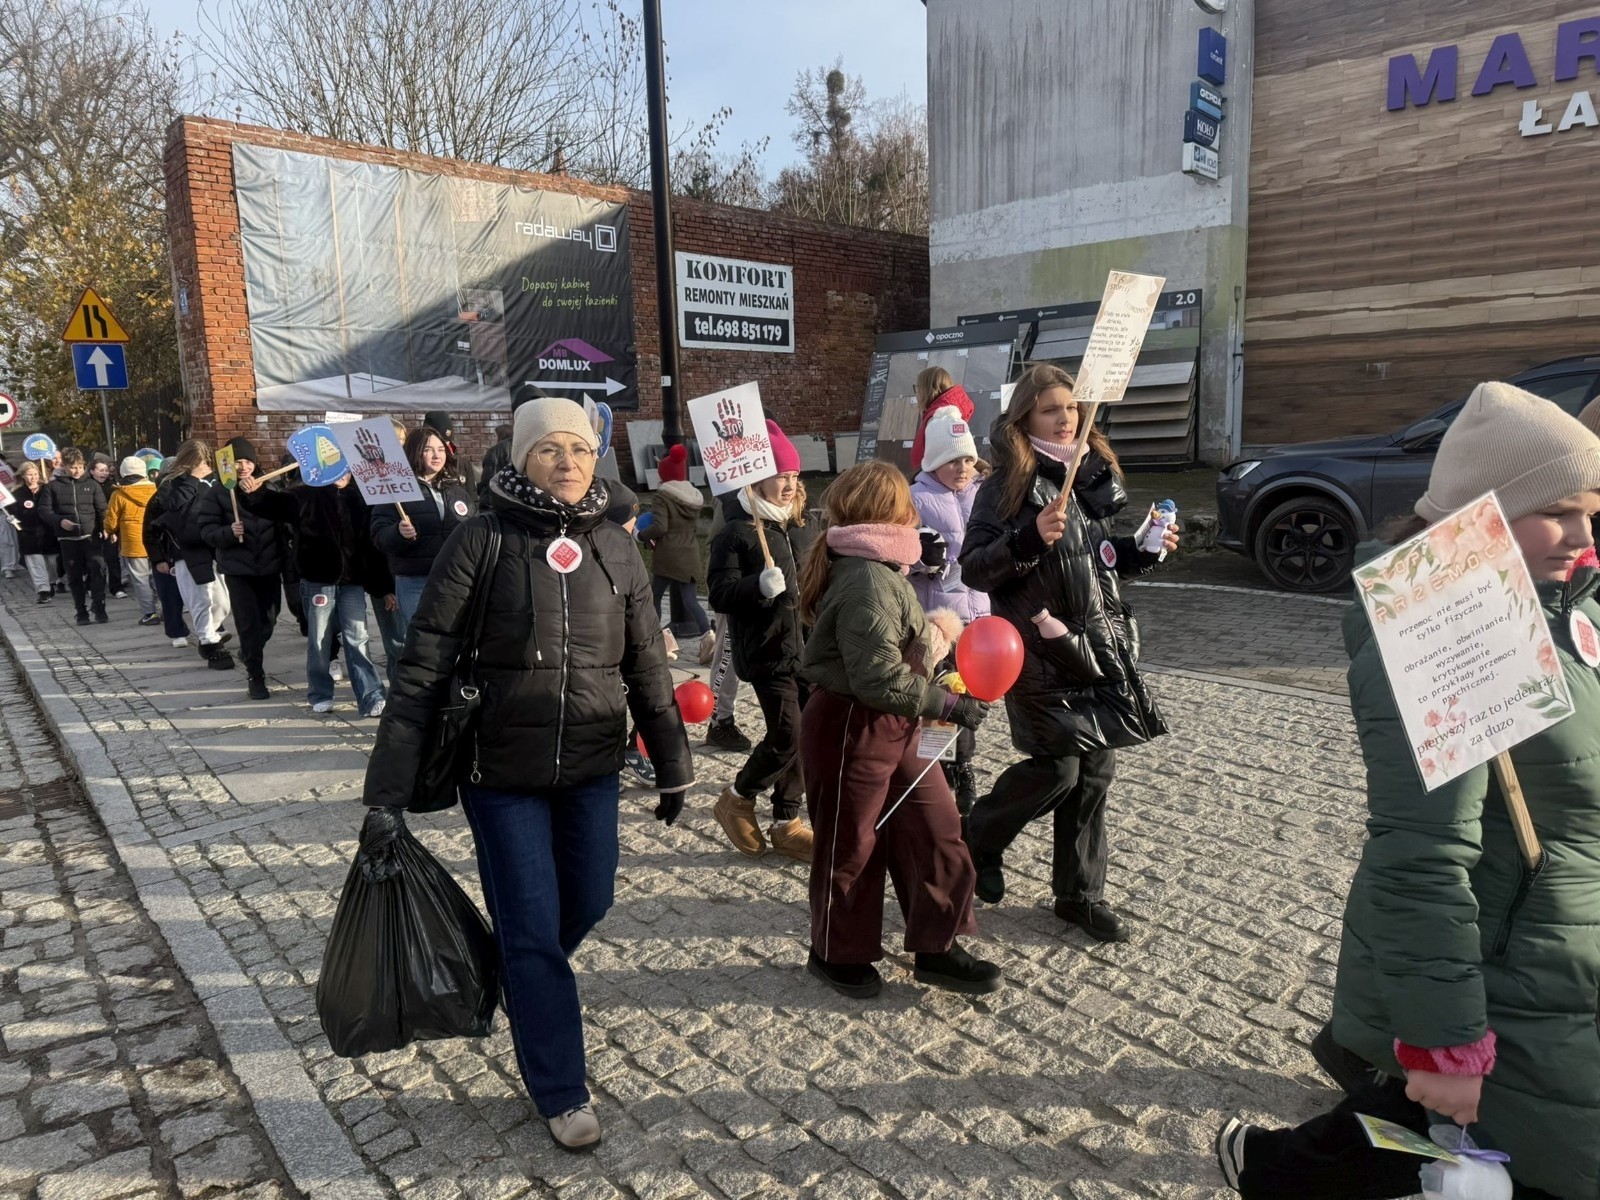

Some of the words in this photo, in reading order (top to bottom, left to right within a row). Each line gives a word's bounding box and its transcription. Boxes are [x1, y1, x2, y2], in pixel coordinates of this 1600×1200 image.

[1519, 91, 1599, 137] ŁA
[515, 217, 592, 250] radaway
[521, 276, 558, 293] Dopasuj
[561, 276, 590, 291] kabinę
[686, 259, 787, 288] KOMFORT
[542, 296, 553, 307] do
[557, 296, 582, 310] swojej
[585, 294, 618, 306] łazienki
[684, 286, 736, 306] REMONTY
[739, 292, 789, 311] MIESZKAŃ
[1175, 292, 1196, 306] 2.0
[741, 321, 760, 340] 851
[762, 324, 782, 342] 179
[538, 358, 591, 371] DOMLUX
[552, 348, 568, 358] MB
[721, 420, 743, 437] STOP
[1363, 551, 1421, 592] STOP
[1375, 537, 1512, 623] PRZEMOCY
[1436, 605, 1452, 617] nie
[1455, 591, 1474, 607] musi
[1477, 580, 1493, 596] być
[1416, 624, 1441, 641] tylko
[1444, 601, 1483, 625] fizyczna
[1432, 648, 1491, 683] krytykowanie
[1435, 642, 1484, 669] wyzywanie,
[1418, 695, 1428, 704] to
[1431, 669, 1475, 698] przykłady
[1478, 647, 1517, 673] przemocy
[1441, 670, 1499, 705] psychicznej.
[1416, 721, 1466, 758] pierwszy
[1469, 711, 1488, 726] raz
[1488, 704, 1502, 715] to
[1502, 684, 1536, 712] jeden
[1539, 674, 1556, 690] raz
[1469, 735, 1483, 746] za
[1485, 717, 1515, 738] duzo
